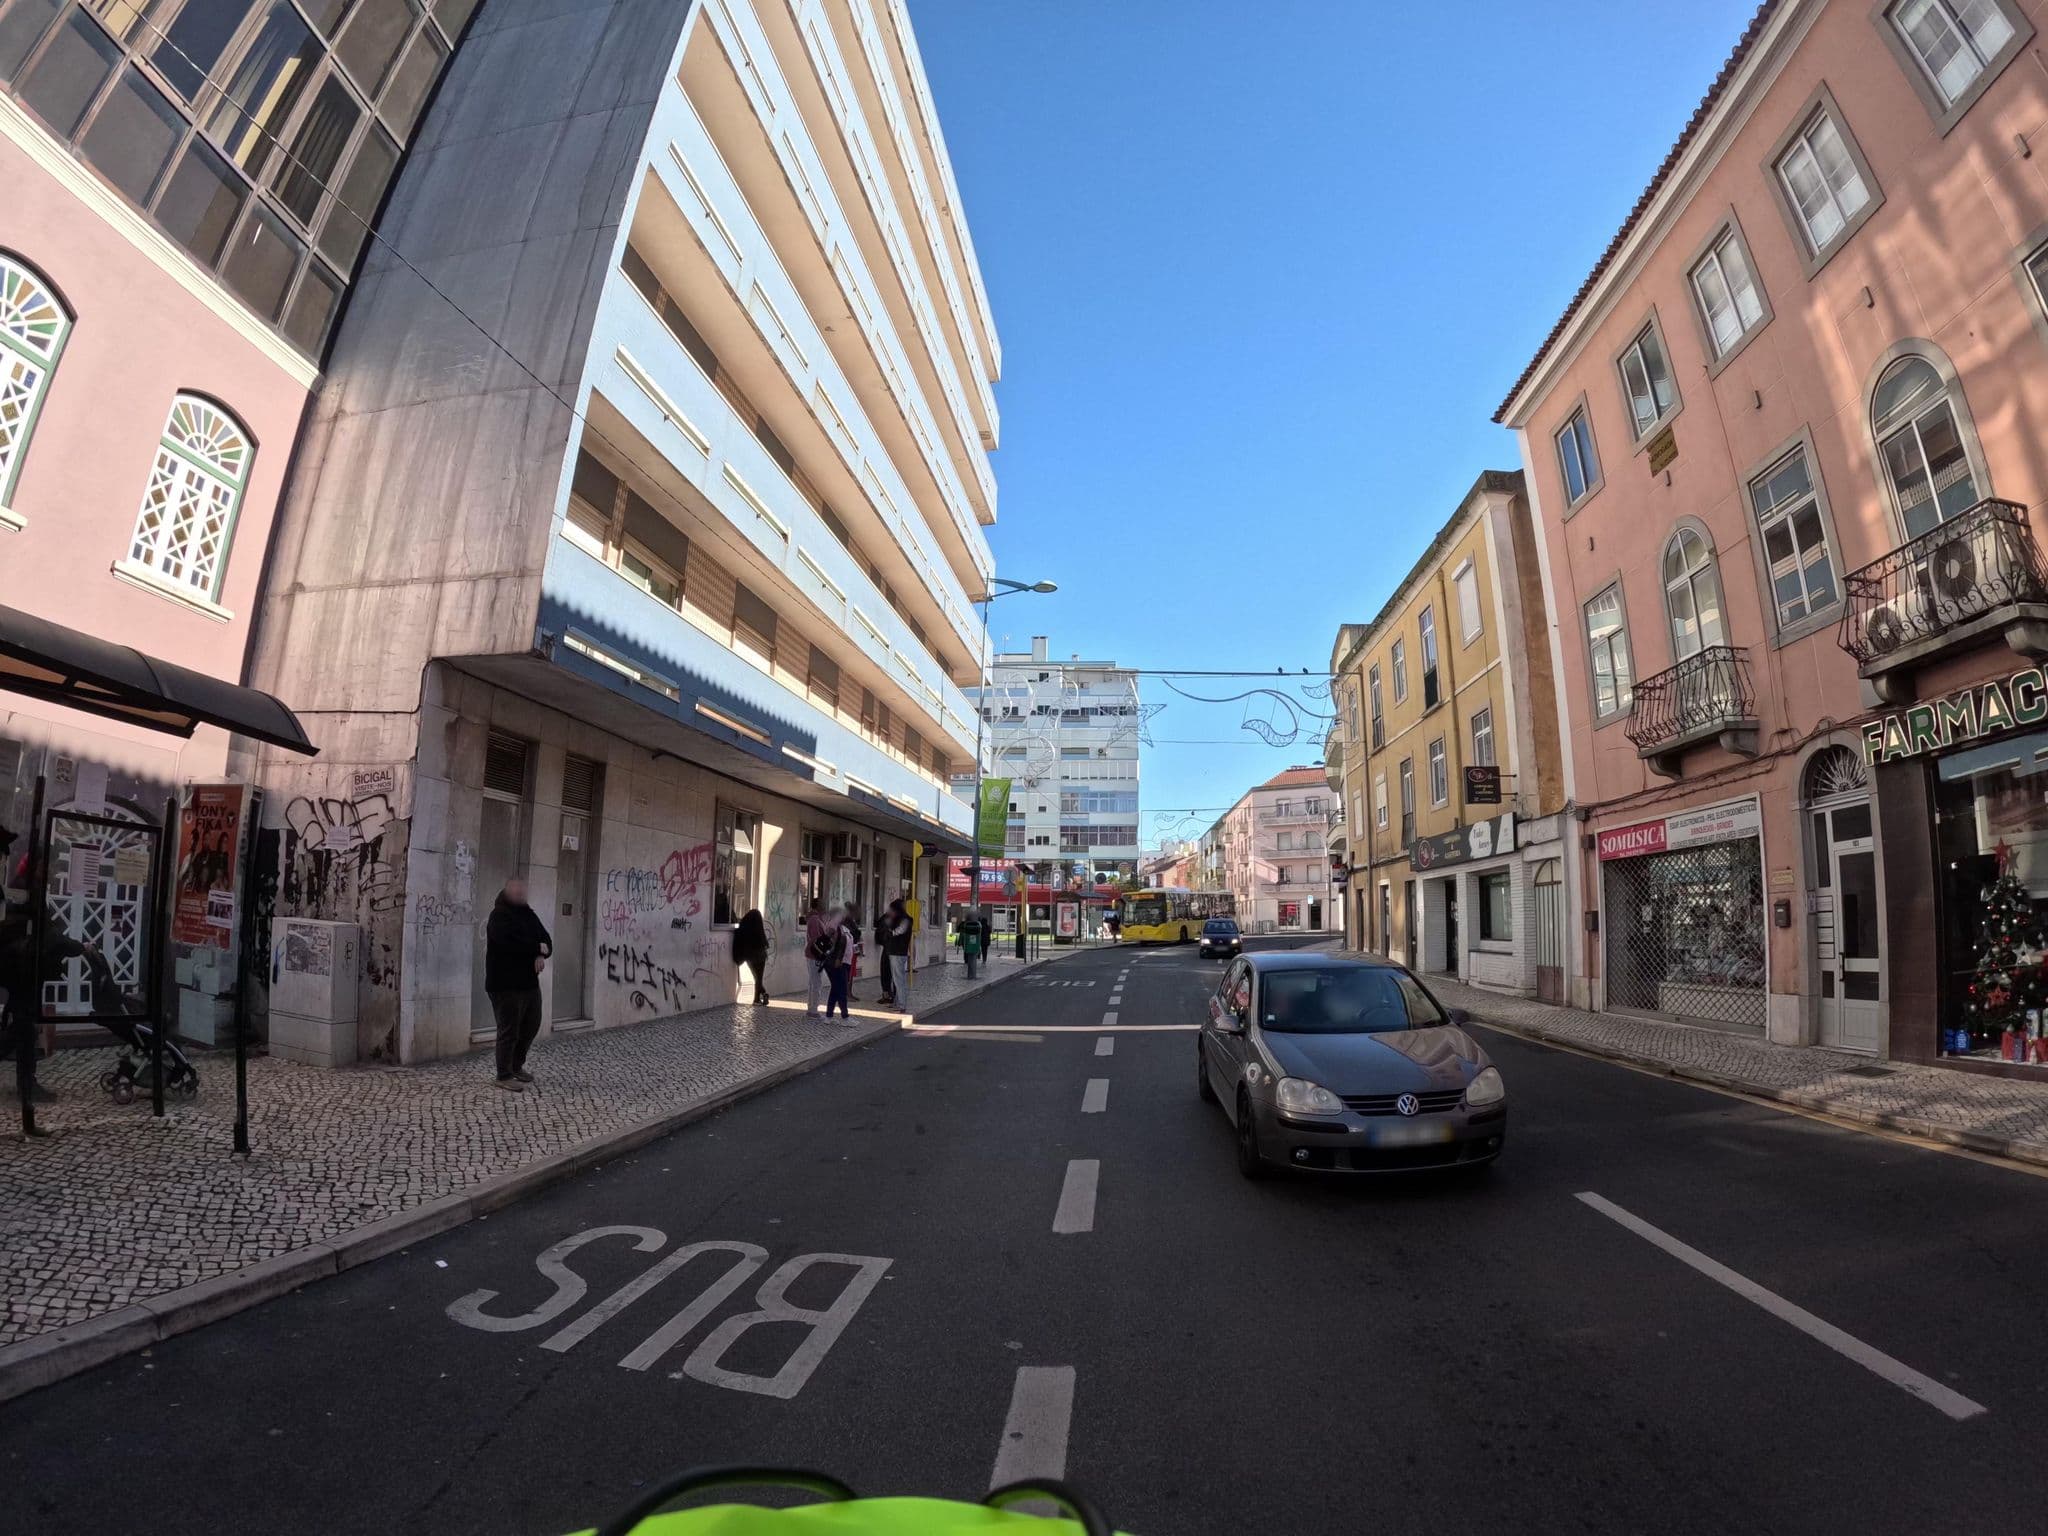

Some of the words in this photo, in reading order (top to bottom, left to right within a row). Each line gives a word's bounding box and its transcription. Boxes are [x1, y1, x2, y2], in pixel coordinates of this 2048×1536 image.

[1861, 664, 2048, 767] FARMAC
[354, 770, 392, 786] BICIGAL
[195, 805, 227, 817] TONY
[1602, 825, 1665, 854] SOMÚSICA
[445, 1225, 894, 1400] BUS
